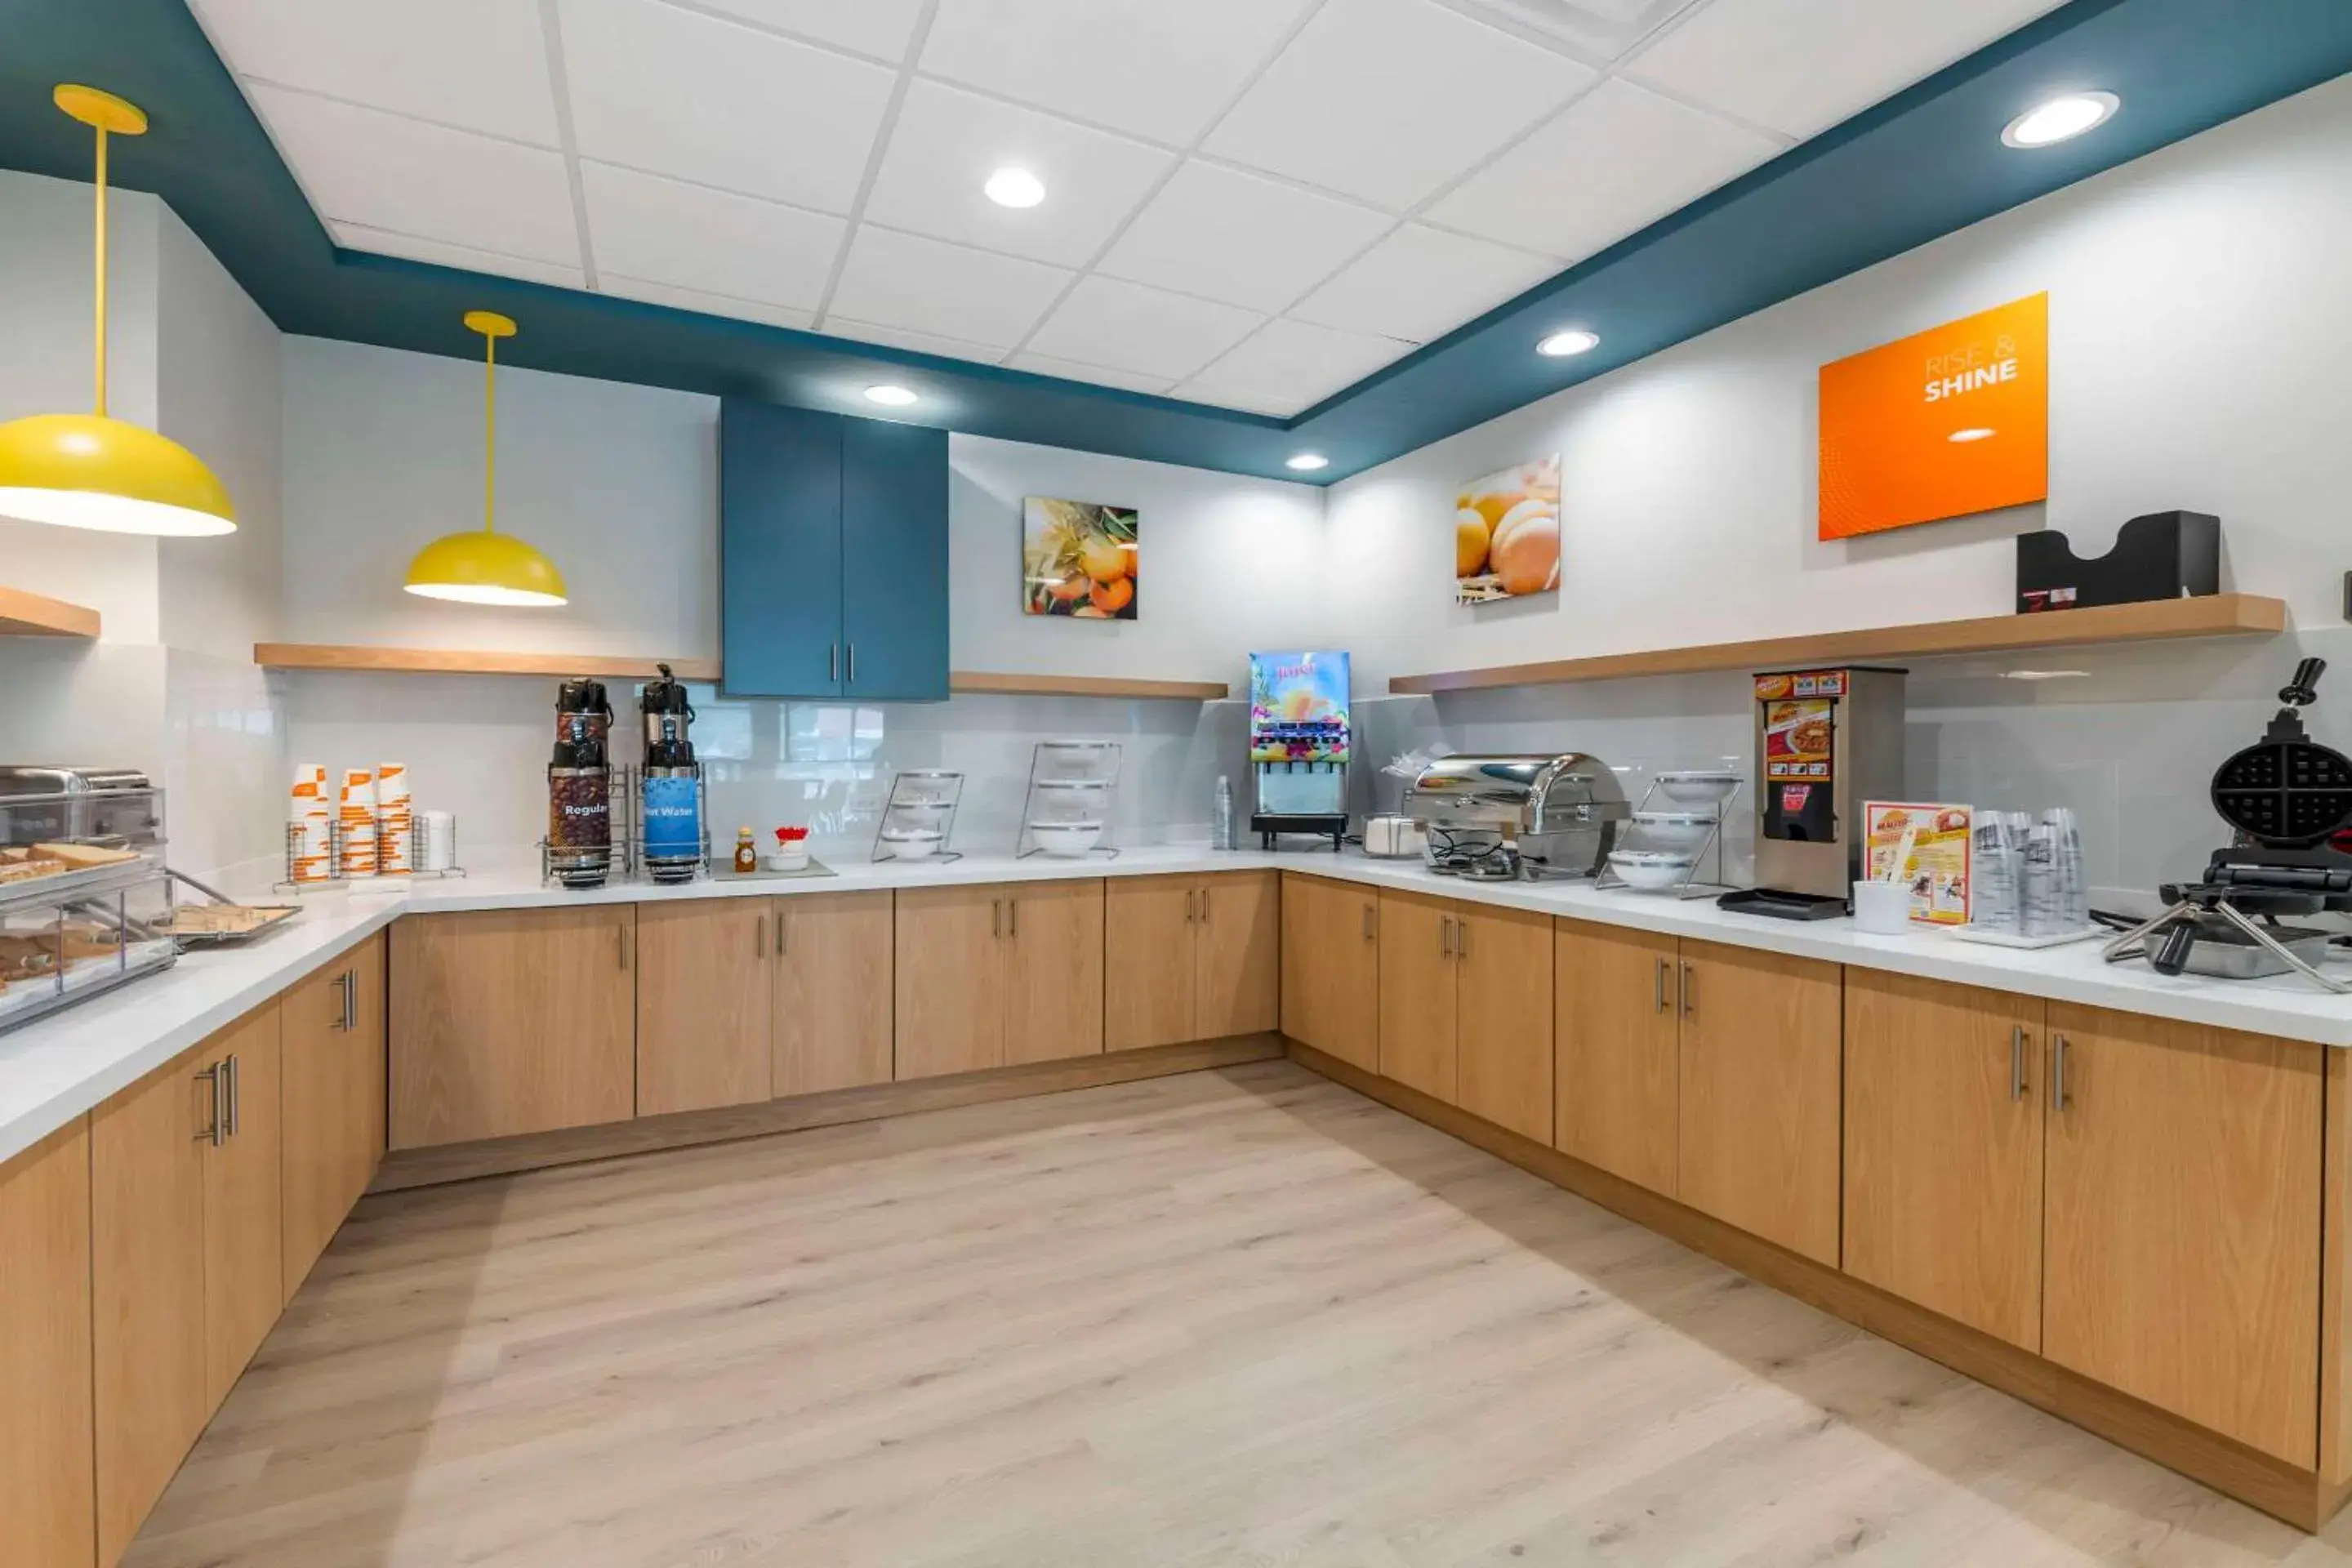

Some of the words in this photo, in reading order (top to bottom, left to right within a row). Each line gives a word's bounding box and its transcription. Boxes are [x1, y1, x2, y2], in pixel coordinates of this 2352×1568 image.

[1924, 358, 2018, 403] SHINE
[1926, 342, 1983, 381] RISE
[1995, 334, 2016, 359] &
